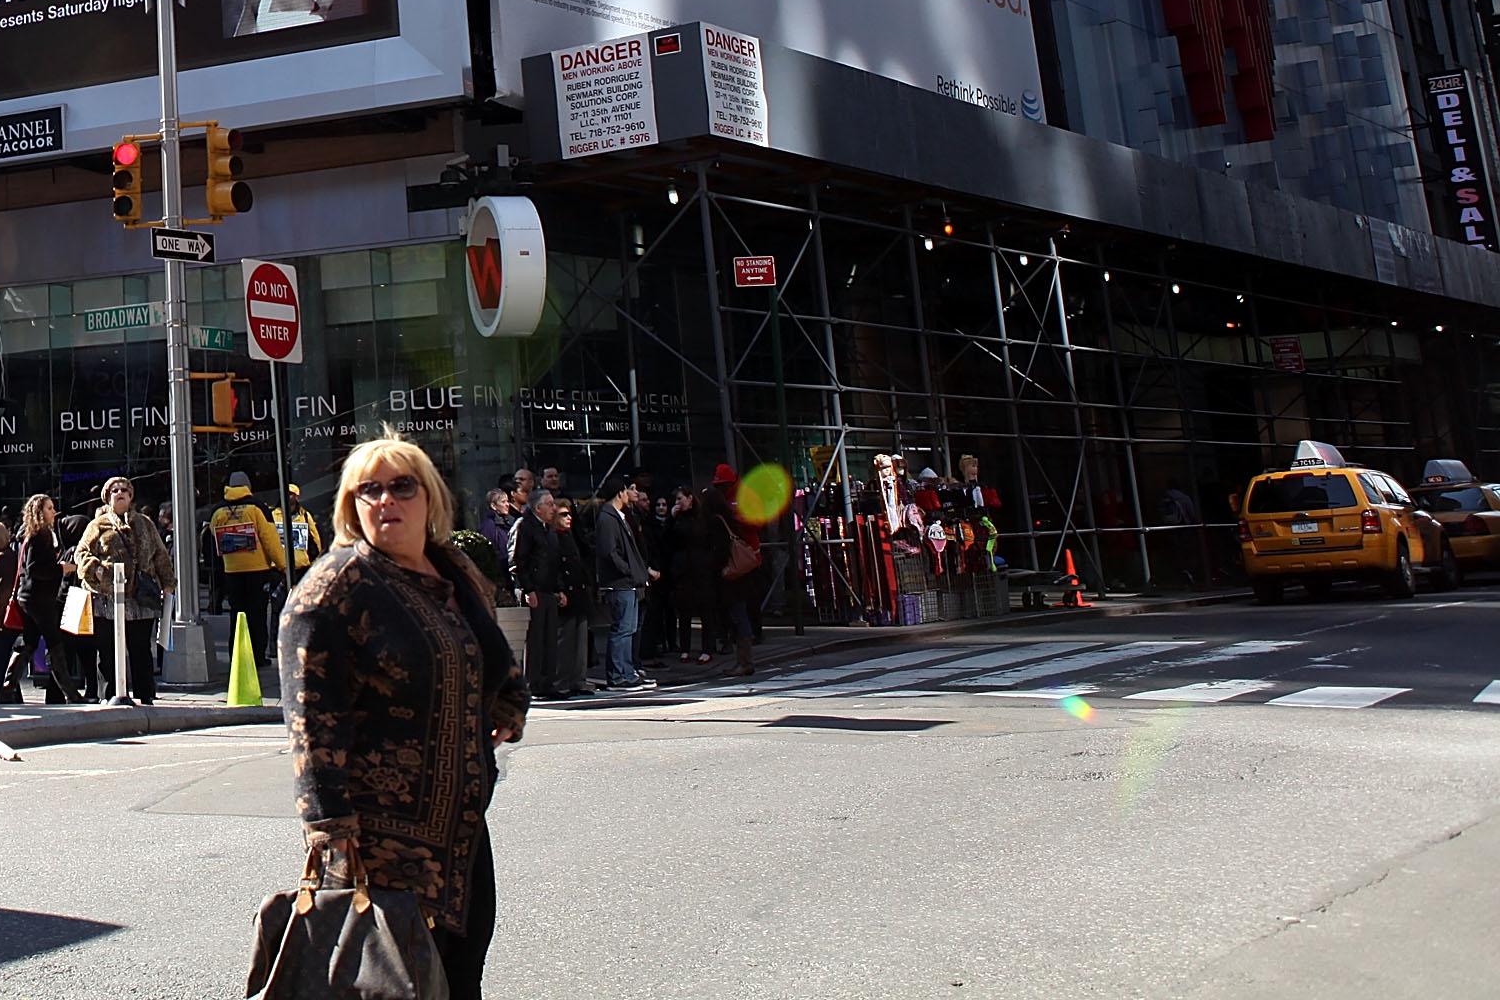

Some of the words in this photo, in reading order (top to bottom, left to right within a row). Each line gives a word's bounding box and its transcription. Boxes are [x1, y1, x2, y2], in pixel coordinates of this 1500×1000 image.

[706, 28, 756, 58] DANGER
[561, 40, 641, 71] DANGER
[563, 72, 578, 80] MEN
[580, 64, 614, 77] WORKING
[618, 59, 642, 70] ABOVE
[566, 88, 604, 102] NEWMARK
[607, 81, 643, 94] BUILDING
[567, 81, 591, 92] RUBEN
[595, 72, 640, 87] RODRIGUEZ
[570, 96, 613, 110] SOLUTIONS
[616, 92, 640, 102] CORP.
[937, 74, 974, 104] Rethink
[976, 87, 1016, 117] Possible
[611, 102, 641, 113] AVENUE
[589, 121, 645, 138] 718-752-9610
[569, 142, 599, 155] RIGGER
[161, 238, 180, 250] ONE
[188, 240, 206, 253] WAY
[467, 238, 502, 309] W
[254, 280, 267, 296] DO
[271, 283, 288, 299] NOT
[87, 306, 150, 331] BROADWAY
[215, 330, 226, 346] 47
[260, 324, 289, 341] ENTER
[296, 395, 336, 418] FIN
[389, 386, 464, 412] BLUE
[60, 408, 121, 431] BLUE
[131, 405, 168, 427] FIN
[397, 419, 454, 432] BRUNCH
[546, 420, 574, 431] LUNCH
[233, 431, 270, 442] SUSHI
[304, 425, 337, 438] RAW
[340, 424, 367, 435] BAR
[71, 439, 114, 450] DINNER
